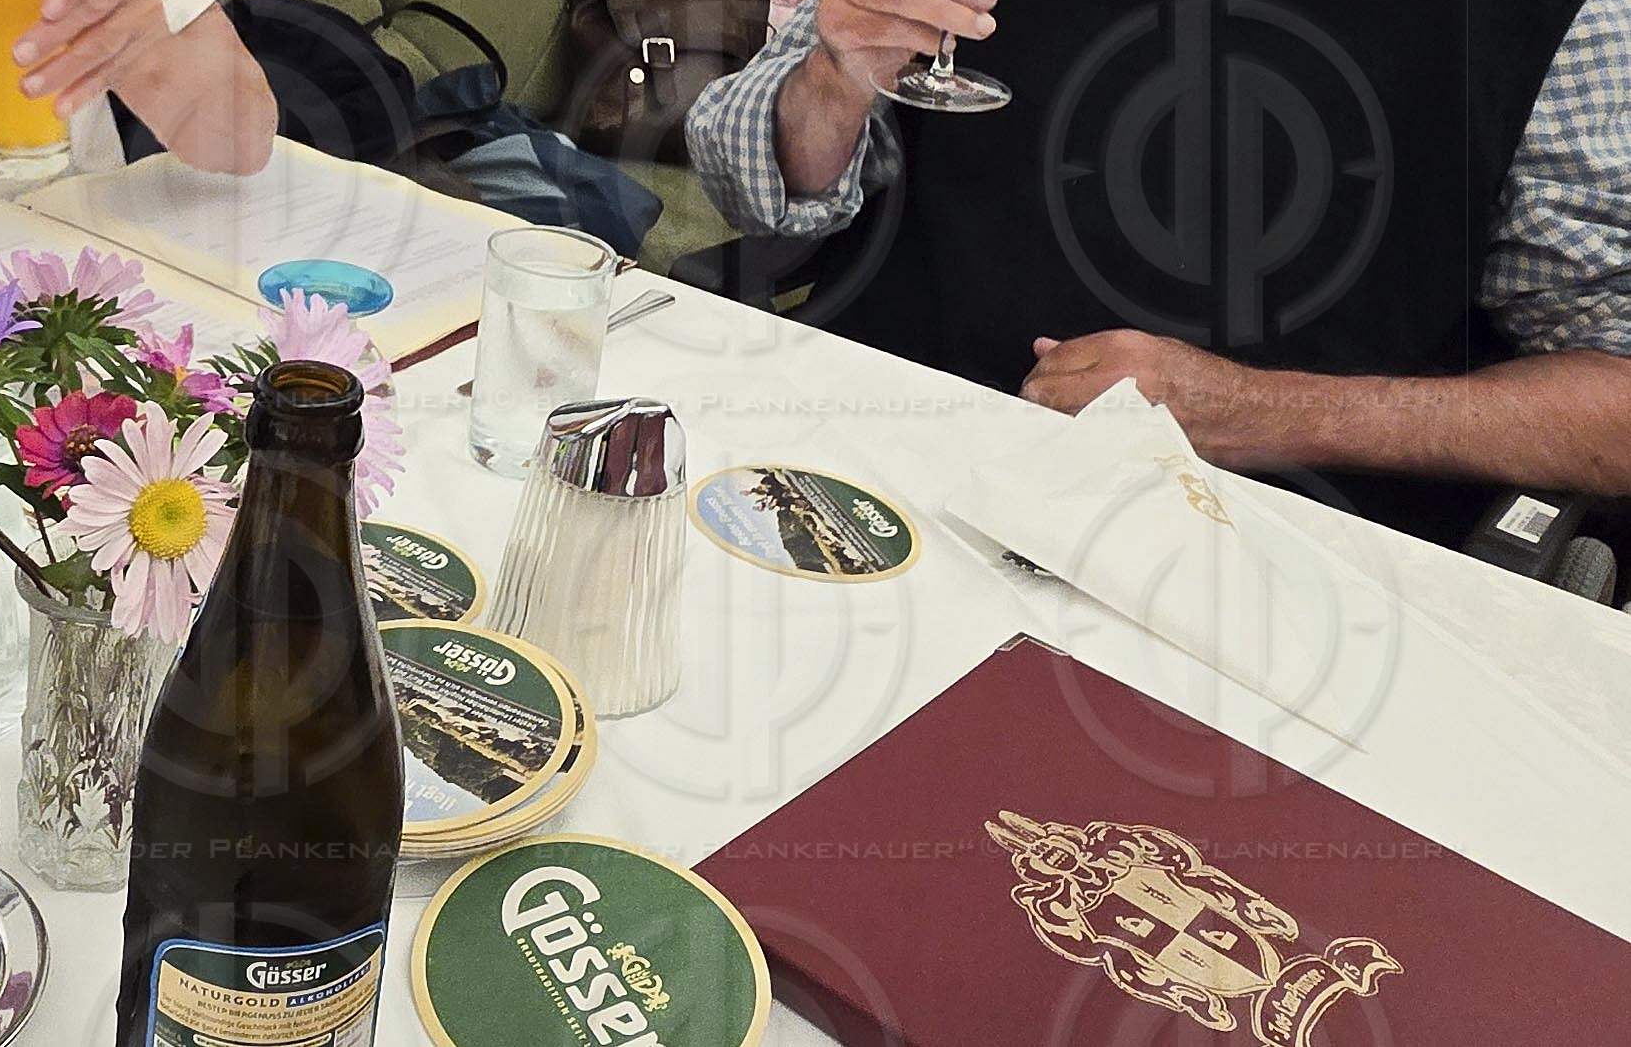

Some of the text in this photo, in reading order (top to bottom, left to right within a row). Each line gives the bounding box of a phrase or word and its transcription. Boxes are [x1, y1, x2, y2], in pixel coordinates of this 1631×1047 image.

[386, 535, 449, 570] Gösser
[433, 640, 517, 686] Gösser
[246, 960, 328, 990] Gösser
[179, 977, 280, 1008] NATURGOLD
